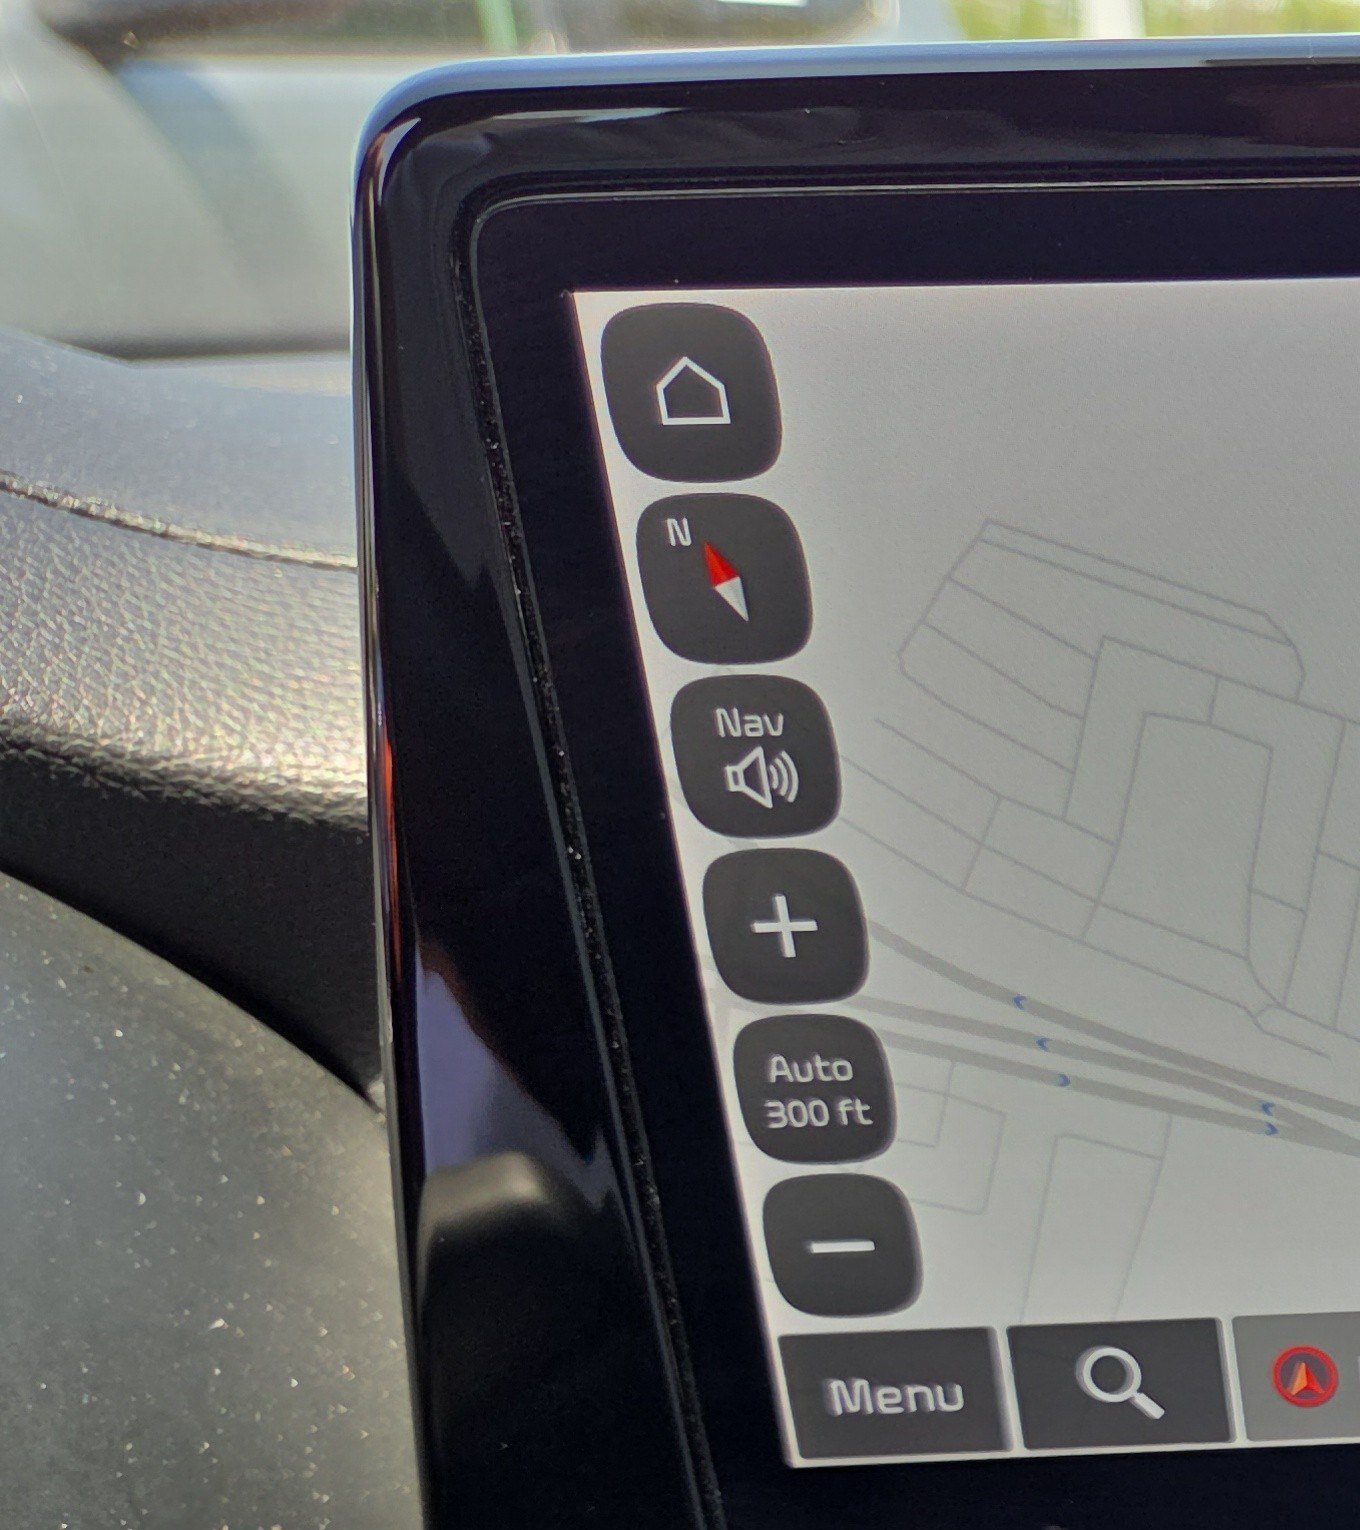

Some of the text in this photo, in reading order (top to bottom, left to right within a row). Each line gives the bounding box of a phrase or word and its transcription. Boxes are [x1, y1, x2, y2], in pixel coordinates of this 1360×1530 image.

[665, 517, 692, 547] N
[714, 706, 784, 738] Nav
[768, 1053, 854, 1083] Auto
[763, 1098, 874, 1129] 300 ft
[826, 1377, 966, 1417] Menu
